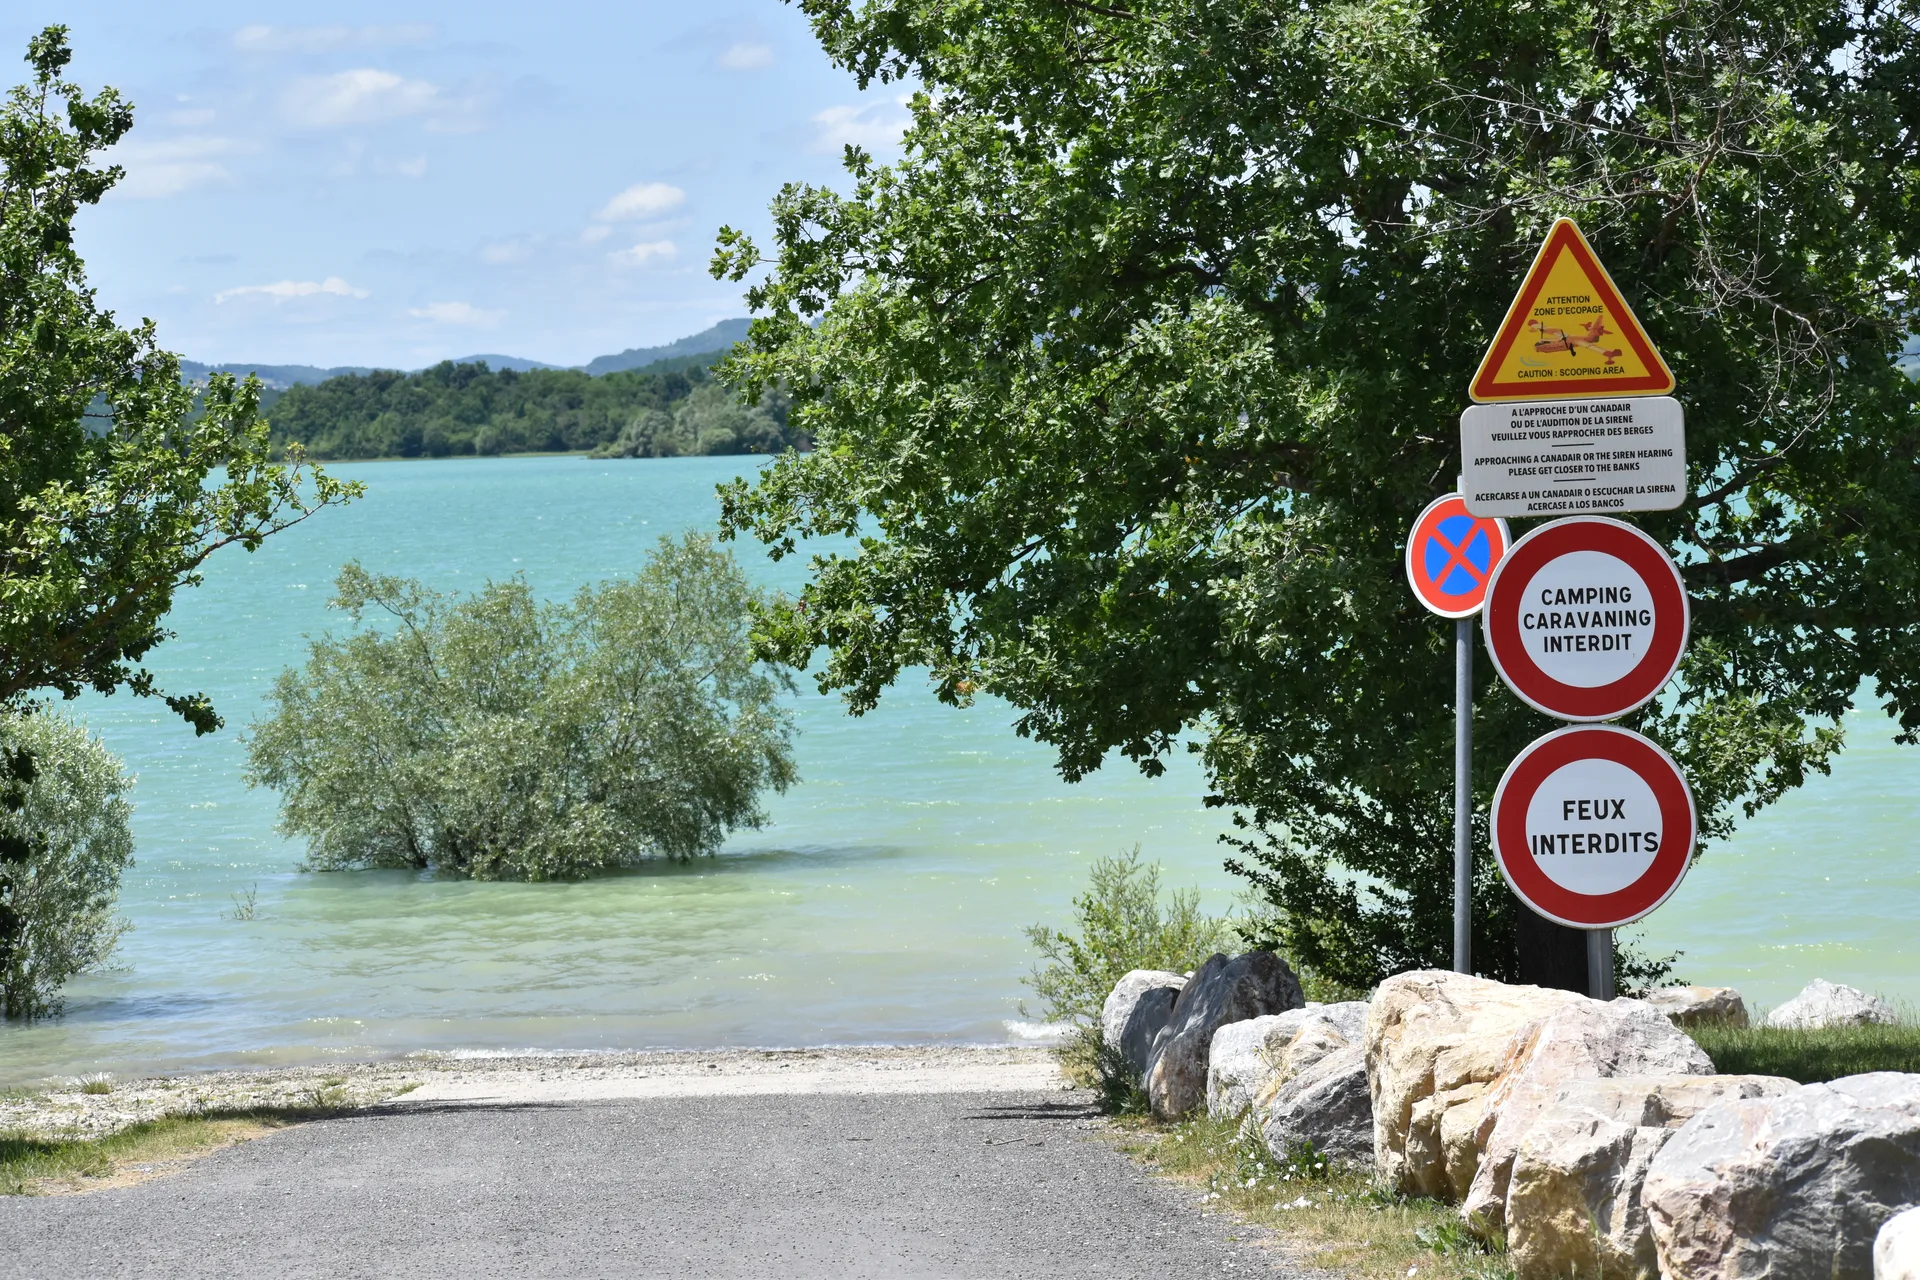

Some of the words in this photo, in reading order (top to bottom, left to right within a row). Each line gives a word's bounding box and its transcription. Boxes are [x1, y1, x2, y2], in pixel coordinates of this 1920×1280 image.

[1547, 296, 1591, 305] ATTENTION
[1534, 307, 1557, 316] ZONE
[1558, 305, 1603, 315] D'ECOPAGE
[1517, 369, 1553, 378] CAUTION
[1559, 367, 1601, 377] SCOOPING
[1602, 366, 1625, 375] AREA
[1519, 407, 1567, 416] L'APPROCHE
[1569, 405, 1589, 414] D'UN
[1590, 403, 1631, 414] CANADAIR
[1511, 420, 1523, 428] OU
[1524, 420, 1535, 428] DE
[1536, 418, 1581, 427] L'AUDITION
[1582, 417, 1592, 425] DE
[1605, 415, 1633, 424] SIRENE
[1491, 432, 1527, 441] VEUILLEZ
[1528, 431, 1551, 440] VOUS
[1552, 428, 1605, 439] RAPPROCHER
[1607, 427, 1622, 436] DES
[1624, 426, 1653, 435] BERGES
[1474, 455, 1532, 466] APPROACHING
[1533, 455, 1539, 463] A
[1540, 452, 1581, 463] CANADAIR
[1583, 452, 1594, 461] OR
[1596, 451, 1611, 460] THE
[1612, 450, 1635, 460] SIREN
[1637, 449, 1673, 458] HEARING
[1508, 467, 1537, 477] PLEASE
[1538, 466, 1552, 475] GET
[1554, 465, 1584, 474] CLOSER
[1585, 464, 1595, 473] TO
[1596, 464, 1611, 472] THE
[1613, 462, 1640, 472] BANKS
[1475, 492, 1520, 502] ACERCARSE
[1528, 491, 1540, 499] UN
[1542, 488, 1583, 498] CANADAIR
[1584, 488, 1591, 496] O
[1593, 486, 1634, 496] ESCUCHAR
[1635, 486, 1645, 494] LA
[1647, 484, 1676, 494] SIRENA
[1527, 501, 1567, 511] ACERCASE
[1568, 501, 1574, 509] A
[1576, 500, 1590, 509] LOS
[1592, 498, 1624, 508] BANCOS
[1541, 587, 1632, 605] CAMPING
[1523, 610, 1651, 629] CARAVANING
[1544, 634, 1632, 653] INTERDIT
[1563, 799, 1626, 821] FEUX
[1532, 832, 1659, 855] INTERDITS
